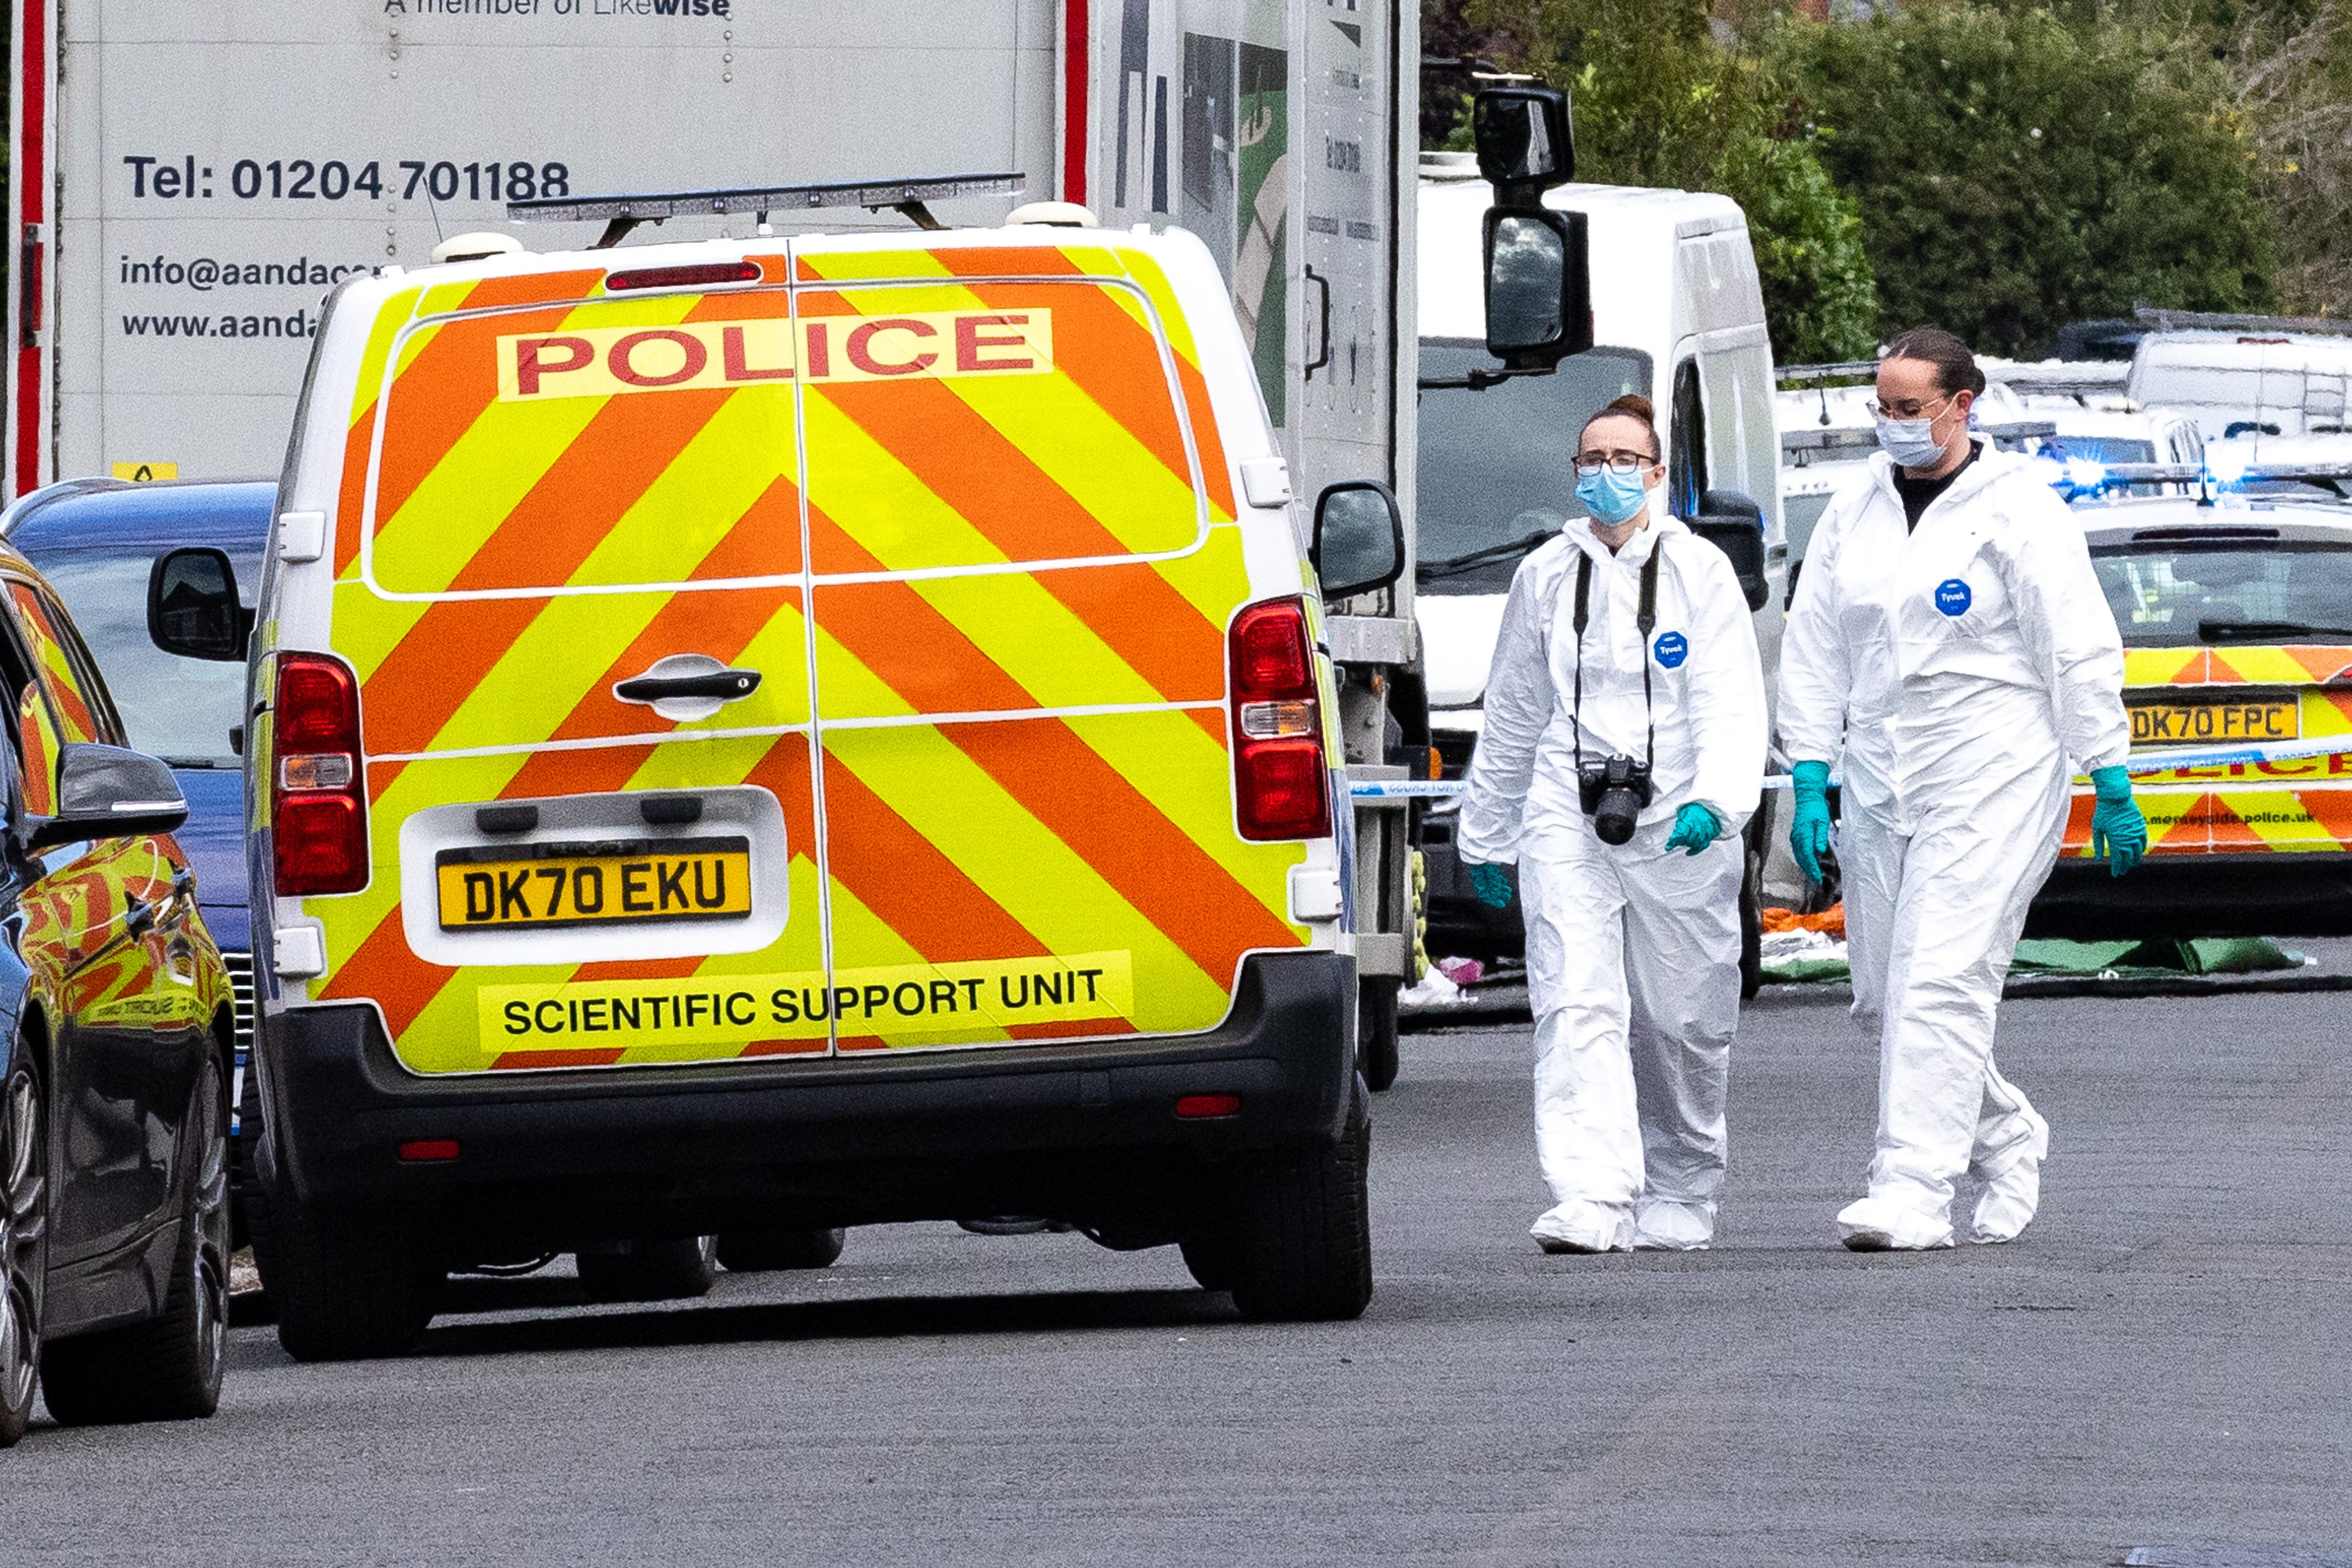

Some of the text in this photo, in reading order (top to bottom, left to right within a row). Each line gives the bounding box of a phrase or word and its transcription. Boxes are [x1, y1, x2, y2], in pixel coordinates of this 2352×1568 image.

[417, 0, 538, 14] member
[595, 0, 730, 15] Likewise
[123, 155, 569, 201] Tel: 01204 701188
[515, 314, 1034, 396] POLICE
[1941, 591, 1966, 603] Tyvek
[1659, 644, 1683, 655] Tyvek
[2132, 706, 2283, 738] DK70 FPC
[464, 860, 726, 922] DK70 EKU
[503, 969, 1103, 1034] SCIENTIFIC SUPPORT UNIT
